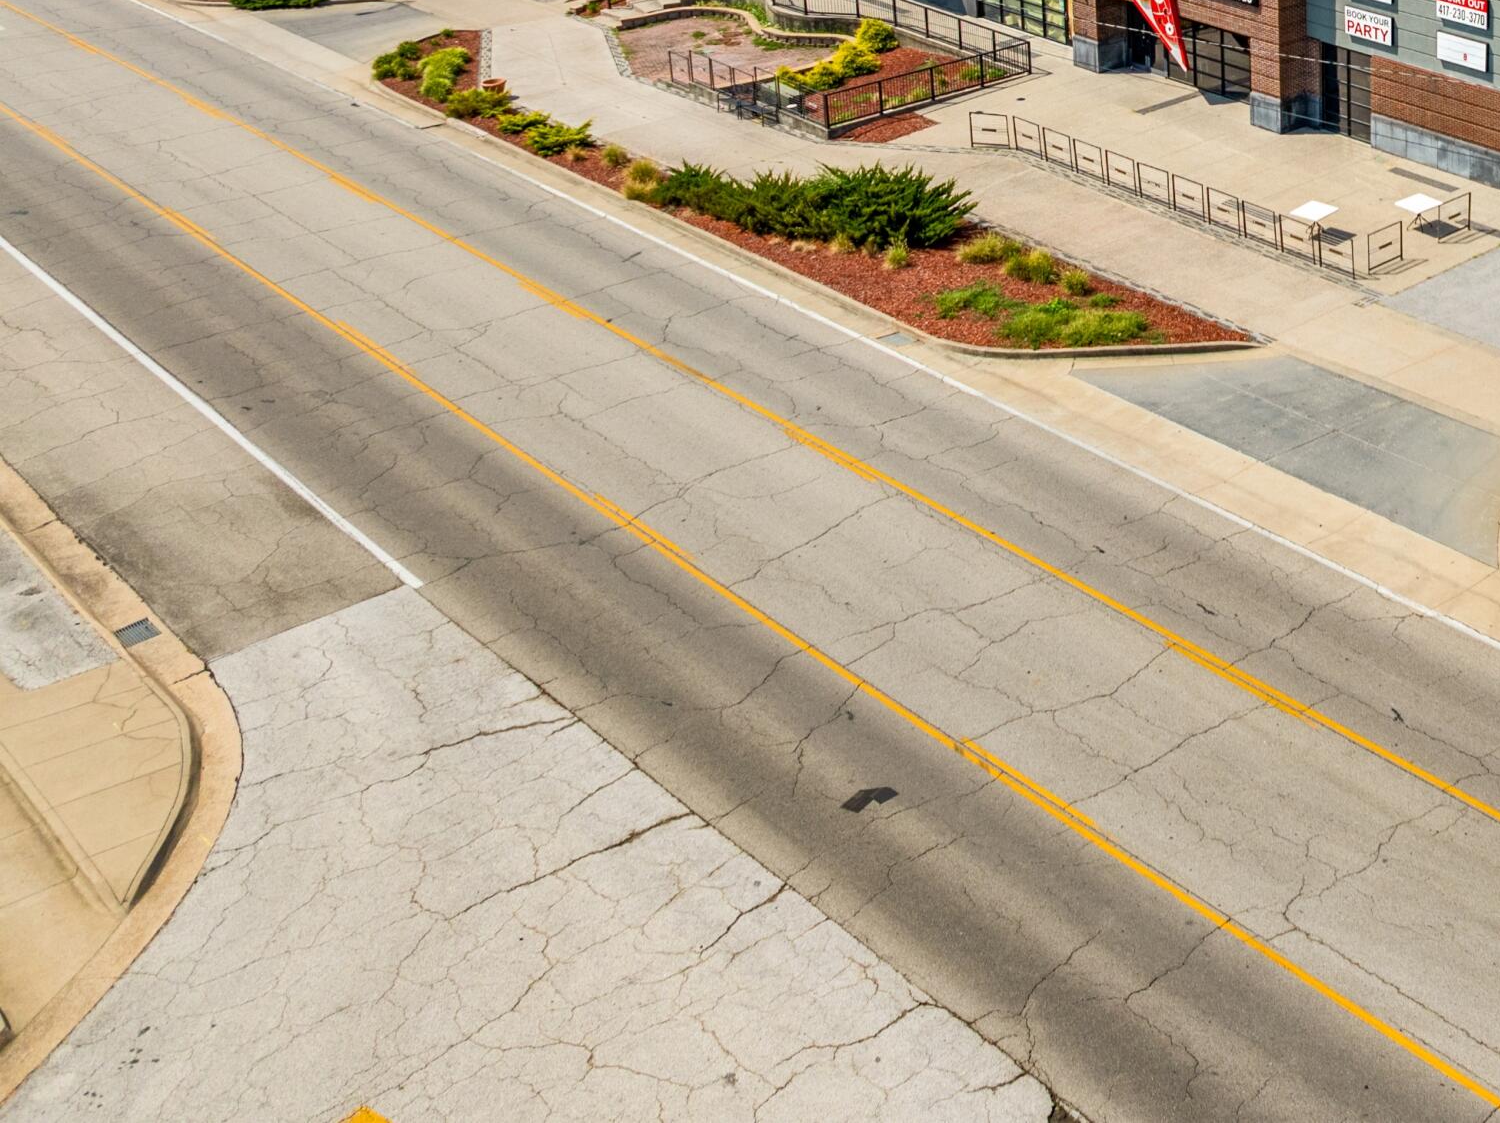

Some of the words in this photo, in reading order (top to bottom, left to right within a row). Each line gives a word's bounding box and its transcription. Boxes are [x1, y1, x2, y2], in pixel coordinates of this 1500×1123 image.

[1346, 9, 1367, 22] BOOK
[1368, 14, 1389, 26] YOUR
[1438, 5, 1486, 26] 417-230-3770
[1347, 20, 1389, 42] PARTY
